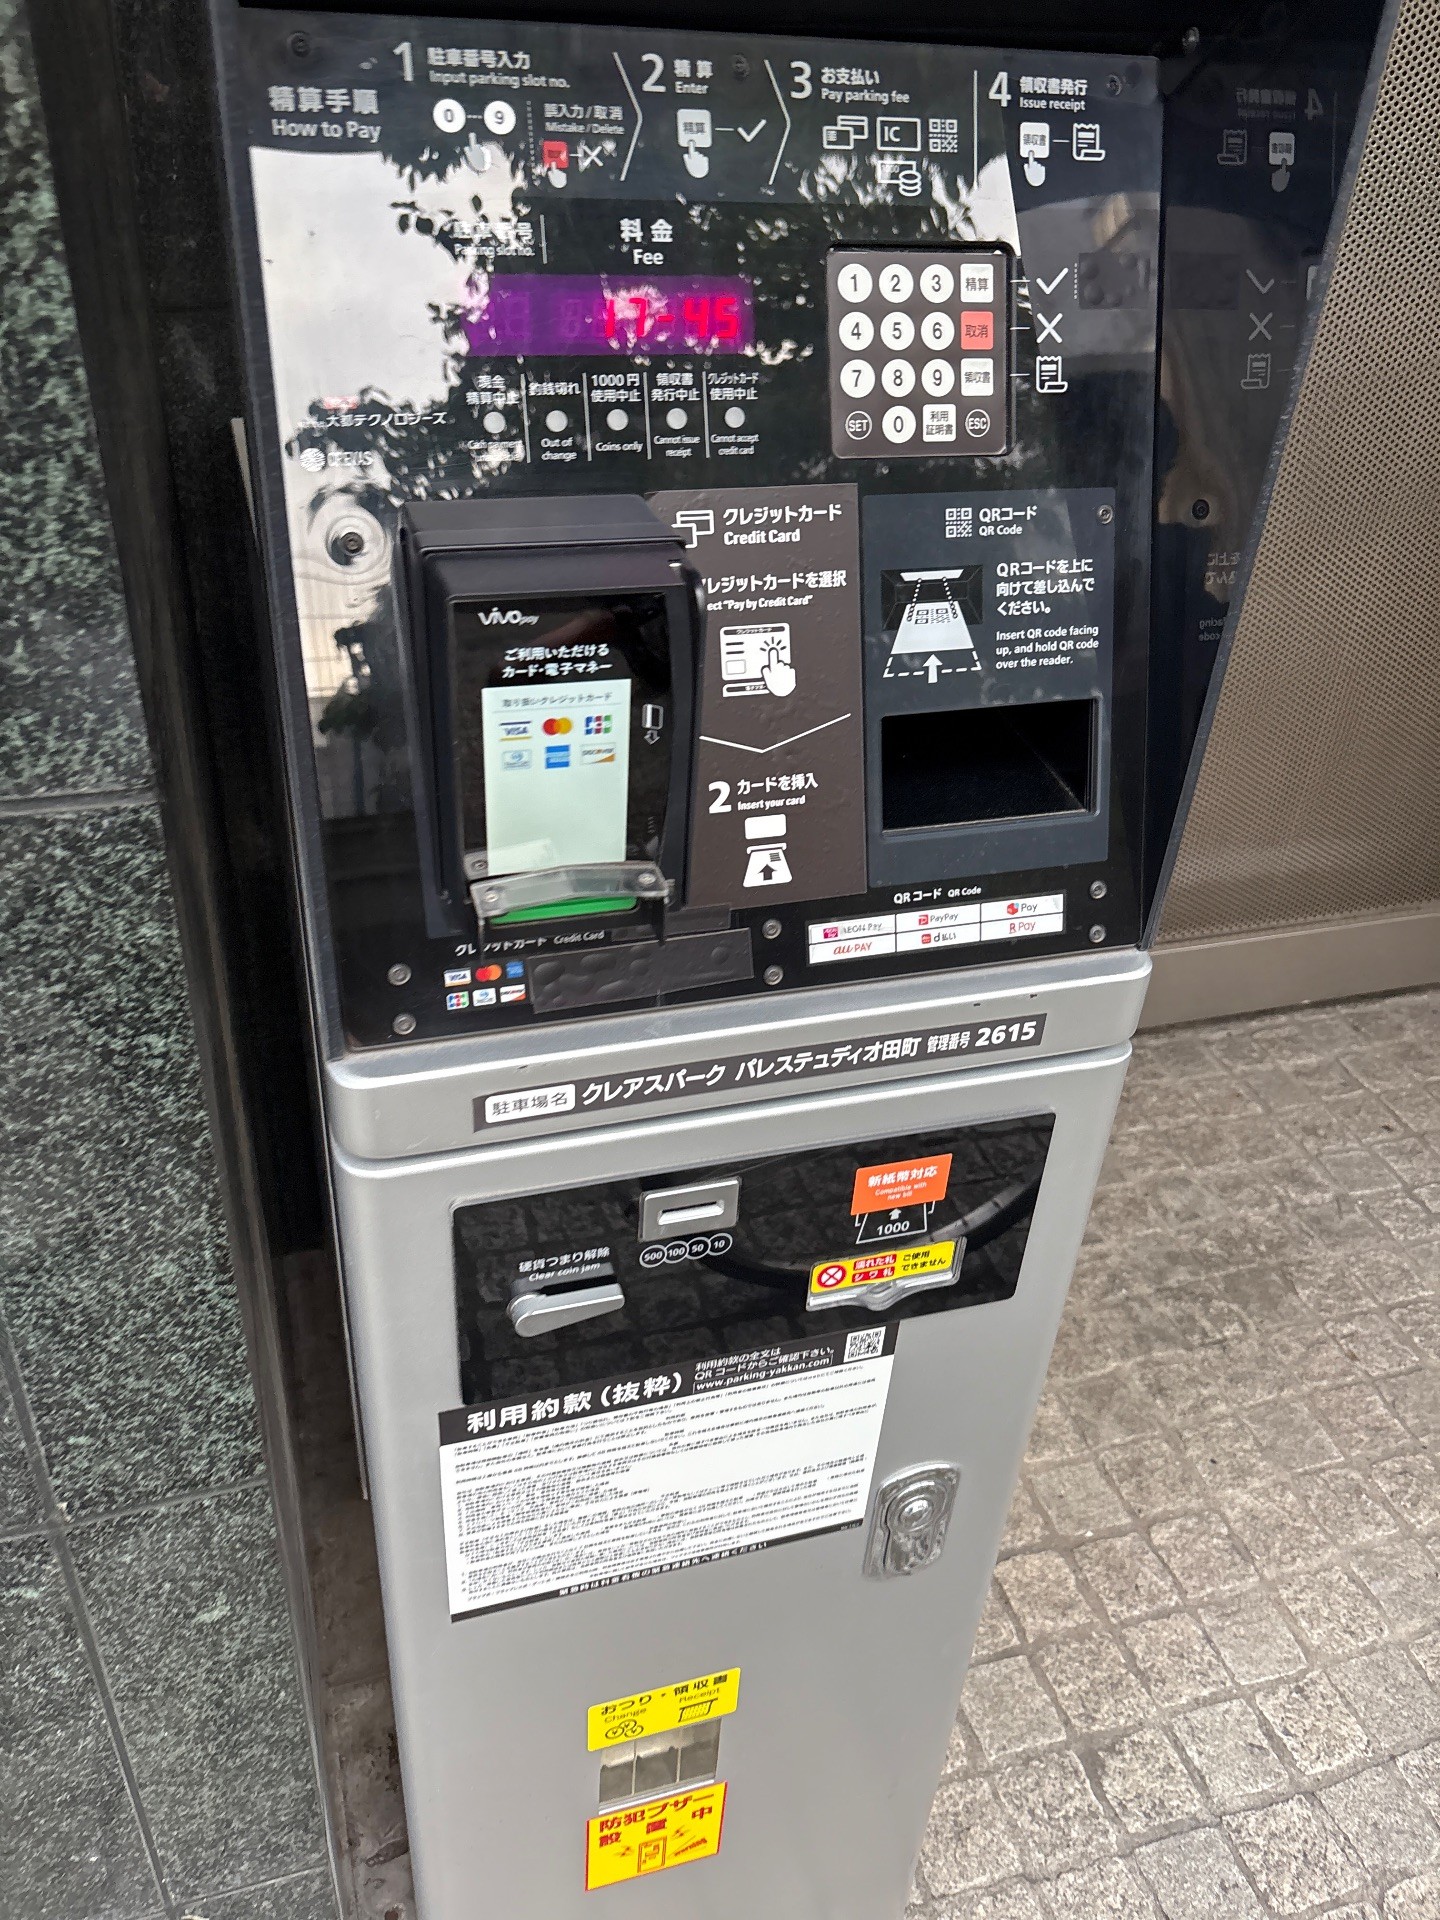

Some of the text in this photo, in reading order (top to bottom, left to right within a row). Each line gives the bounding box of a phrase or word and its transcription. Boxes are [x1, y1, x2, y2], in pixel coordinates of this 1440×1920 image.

[393, 42, 414, 81] 1
[427, 47, 531, 70] 駐車番号入力
[641, 54, 666, 93] 2
[674, 59, 712, 79] 精算
[821, 67, 880, 86] お支払い
[429, 70, 571, 89] Input parking slot no.
[675, 81, 708, 95] Enter
[790, 61, 813, 99] 3
[1020, 76, 1088, 96] 領収書発行
[821, 88, 910, 105] Pay parking fee
[988, 71, 1012, 108] 4
[268, 85, 380, 115] 精算手順
[1020, 97, 1086, 113] Issue receipt
[444, 108, 454, 123] 0
[494, 111, 504, 124] 9
[272, 119, 381, 143] How to Pay
[884, 126, 901, 142] IC
[619, 217, 673, 244] 料金
[633, 249, 664, 266] Fee
[850, 274, 858, 292] 1
[891, 274, 901, 292] 2
[931, 274, 942, 292] 3
[965, 277, 988, 291] 精算
[851, 322, 861, 340] 4
[892, 321, 902, 339] 5
[932, 322, 942, 339] 6
[965, 324, 988, 338] 取消
[477, 375, 505, 389] 現金
[656, 372, 694, 386] 領収書
[708, 372, 759, 385] クレジットカード
[852, 370, 862, 388] 7
[893, 370, 903, 387] 8
[933, 369, 942, 386] 9
[529, 382, 581, 397] 釣銭切れ
[591, 389, 642, 403] 使用中止
[651, 388, 700, 402] 発行中止
[709, 387, 758, 400] 使用中止
[848, 419, 868, 431] SET
[893, 416, 903, 433] 0
[930, 411, 949, 422] 利用
[968, 418, 987, 430] ESC
[541, 437, 573, 448] Out of
[596, 441, 643, 453] Coins only
[542, 450, 577, 462] change
[723, 503, 842, 526] クレジットカード
[979, 506, 1038, 524] QRコード
[724, 528, 801, 545] Credit Card
[978, 524, 1023, 537] QR Code
[996, 558, 1094, 577] QRコードを上に
[702, 569, 847, 594] レジットカードを選択
[996, 577, 1095, 598] 向けて差し込んで
[746, 595, 787, 612] by Credit
[996, 600, 1051, 617] ください。
[996, 625, 1099, 641] Insert QR code facing
[504, 643, 609, 662] ご利用いただける
[995, 639, 1099, 658] up, and hold QR code
[502, 662, 613, 678] カード・電子マネー
[996, 655, 1074, 670] over the reader.
[737, 772, 819, 796] カードを挿入
[708, 780, 732, 815] 2
[737, 795, 806, 812] Insert your card
[893, 888, 942, 904] QRコード
[948, 886, 982, 898] QR Code
[930, 913, 959, 923] PayPay
[1018, 921, 1036, 932] Pay
[554, 930, 604, 945] Credit Card
[834, 942, 872, 955] au PAY
[449, 973, 467, 981] VISA
[492, 1021, 1036, 1116] 駐車場名 クレアスパーク パレステュディオ田町 管理番号 2615
[867, 1165, 938, 1187] 新紙幣対応
[875, 1181, 927, 1196] Compatible with
[903, 1190, 913, 1199] bill
[876, 1220, 910, 1236] 1000
[668, 1247, 685, 1257] 100
[691, 1243, 704, 1253] 50
[713, 1240, 725, 1250] 10
[519, 1247, 610, 1273] 硬貨つまり解除
[644, 1251, 662, 1261] 500
[901, 1258, 946, 1271] できません
[903, 1250, 931, 1262] ご使用
[529, 1262, 601, 1282] Clear coin jam
[695, 1346, 782, 1371] 利用約款の全文は
[696, 1357, 830, 1391] www.parking-yakkan.com
[679, 1687, 720, 1704] Receipt
[605, 1708, 647, 1724] Change
[599, 1794, 714, 1834] 防犯ブザー
